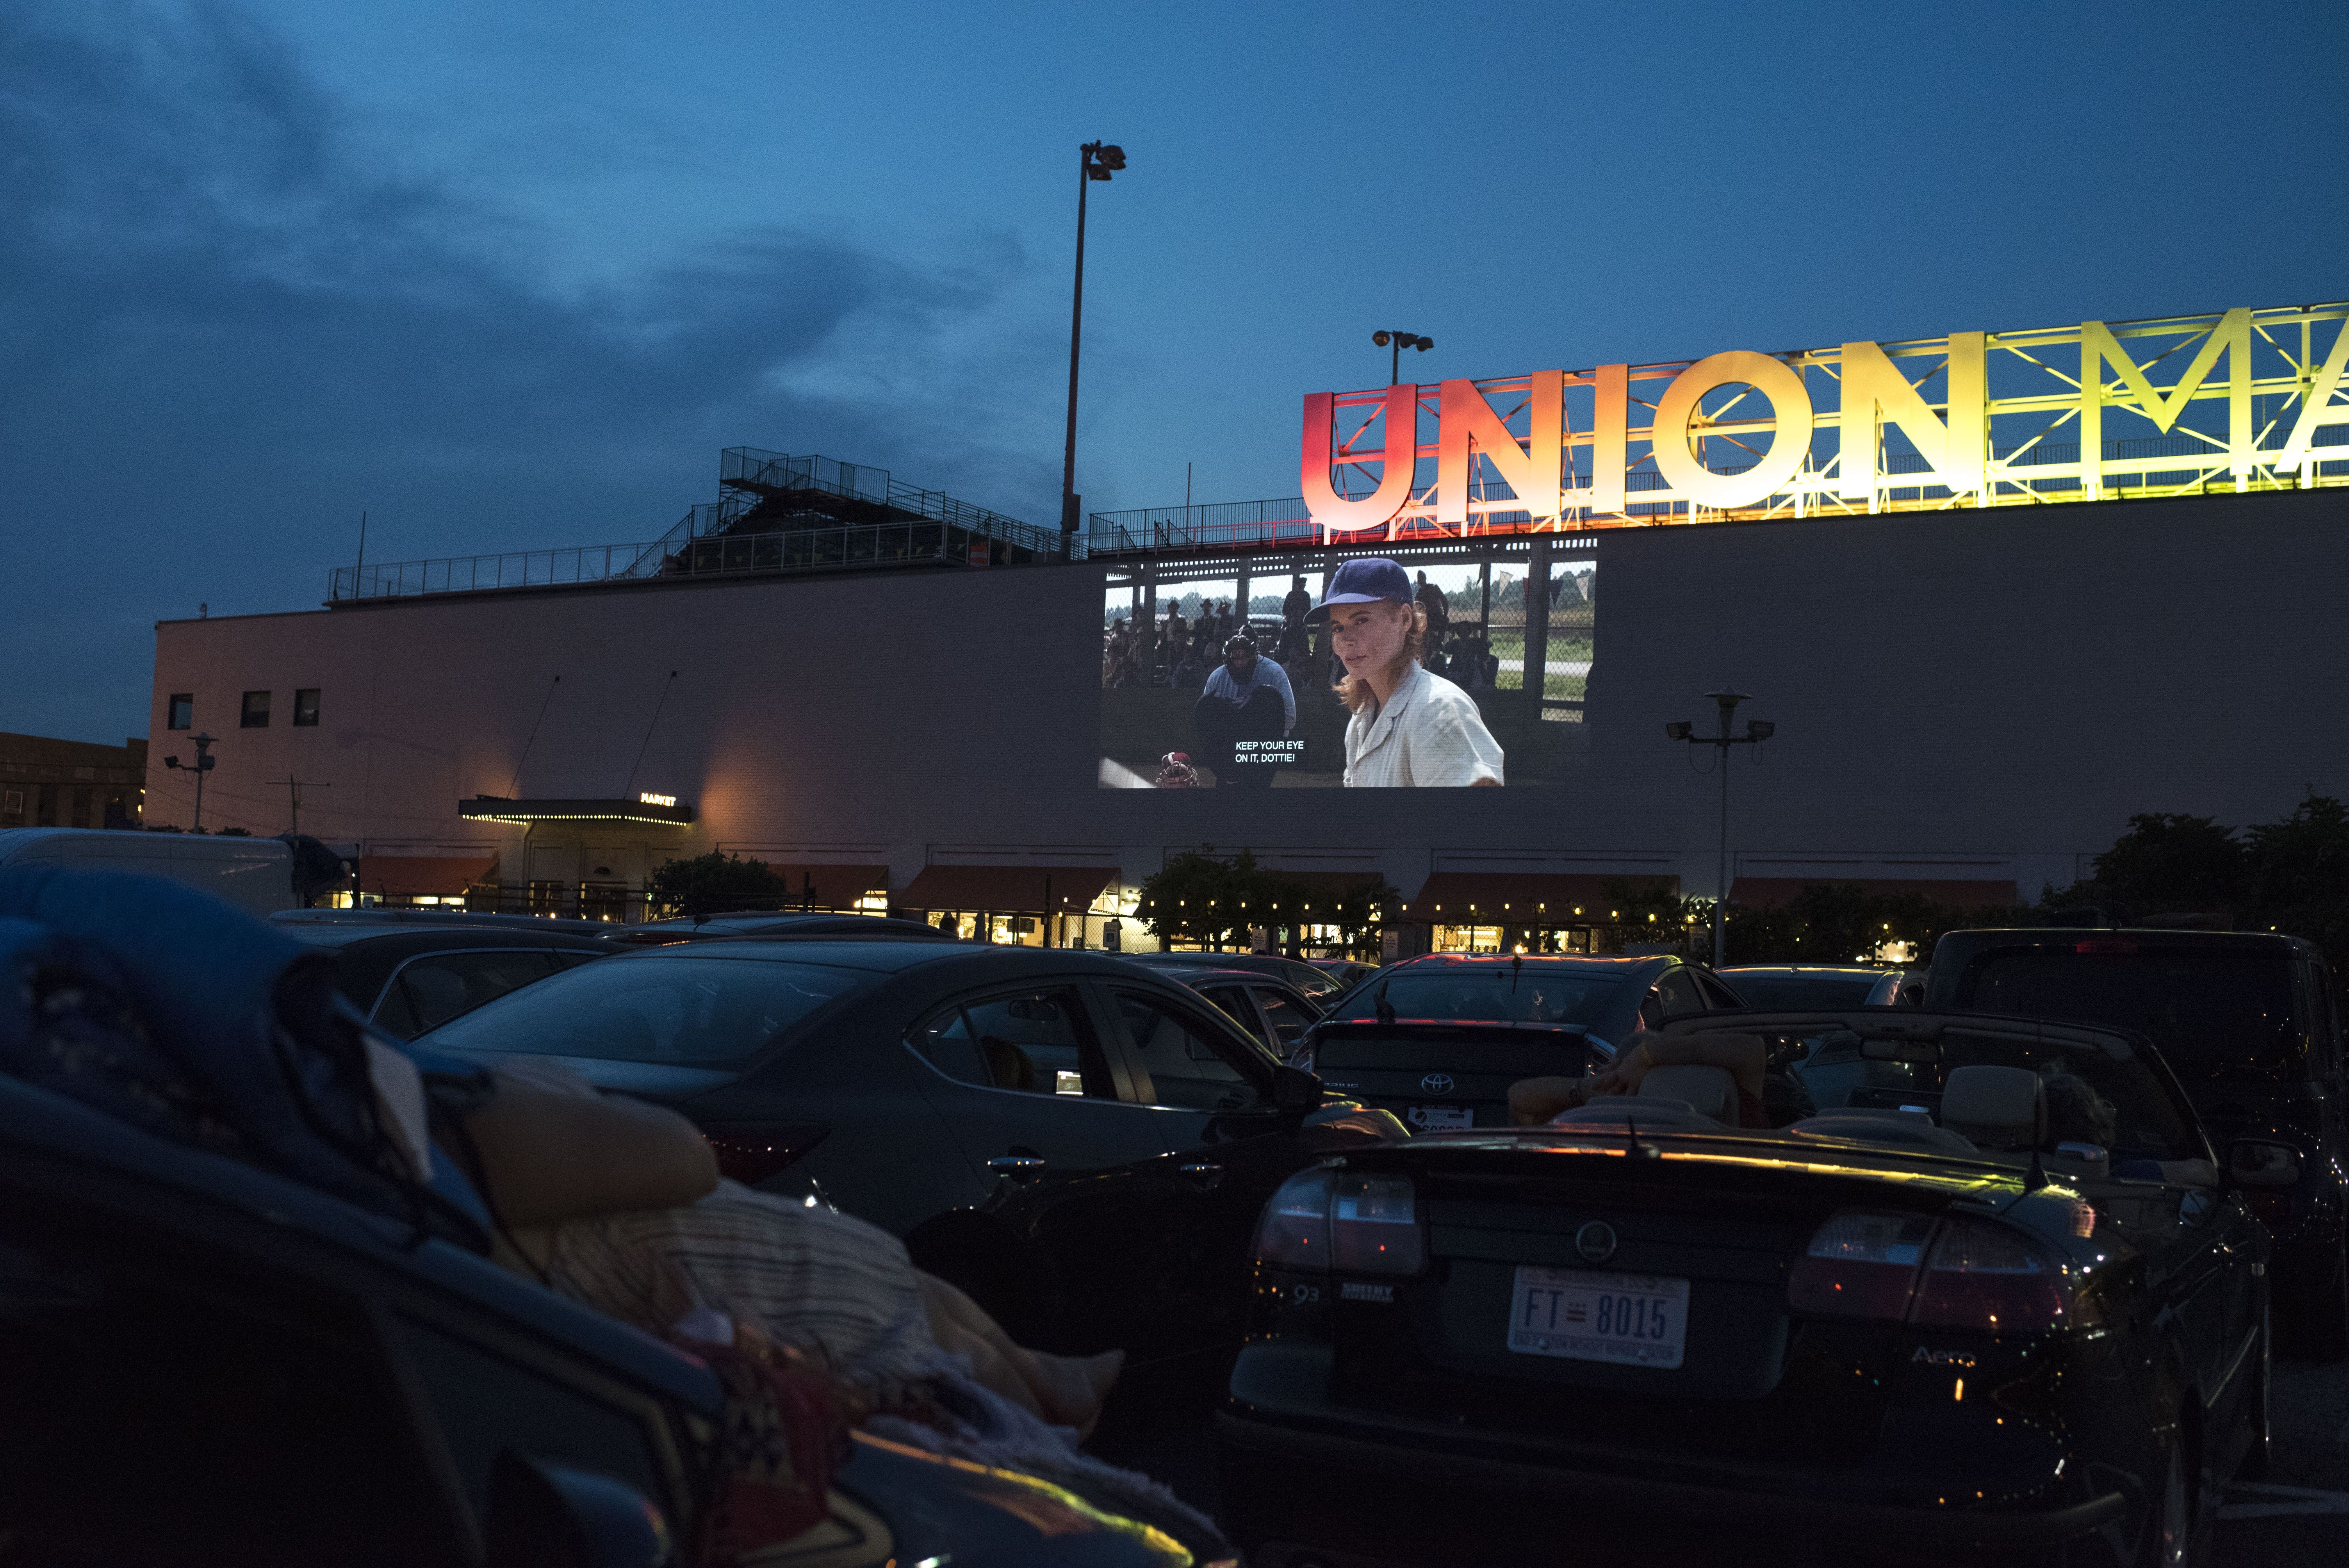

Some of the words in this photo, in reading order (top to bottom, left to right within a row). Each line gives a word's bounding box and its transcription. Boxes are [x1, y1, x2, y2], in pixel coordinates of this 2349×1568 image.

[1301, 331, 1985, 532] UNION
[1236, 741, 1258, 750] KEEP
[1260, 741, 1285, 750] YOUR
[1287, 741, 1304, 749] EYE
[1235, 754, 1248, 763] ON
[1250, 754, 1259, 763] IT,
[1261, 754, 1295, 762] DOTTIE!
[641, 793, 676, 806] MARKET
[1526, 1288, 1563, 1329] FT
[1597, 1295, 1666, 1339] 8015
[1912, 1346, 1977, 1367] Aero
